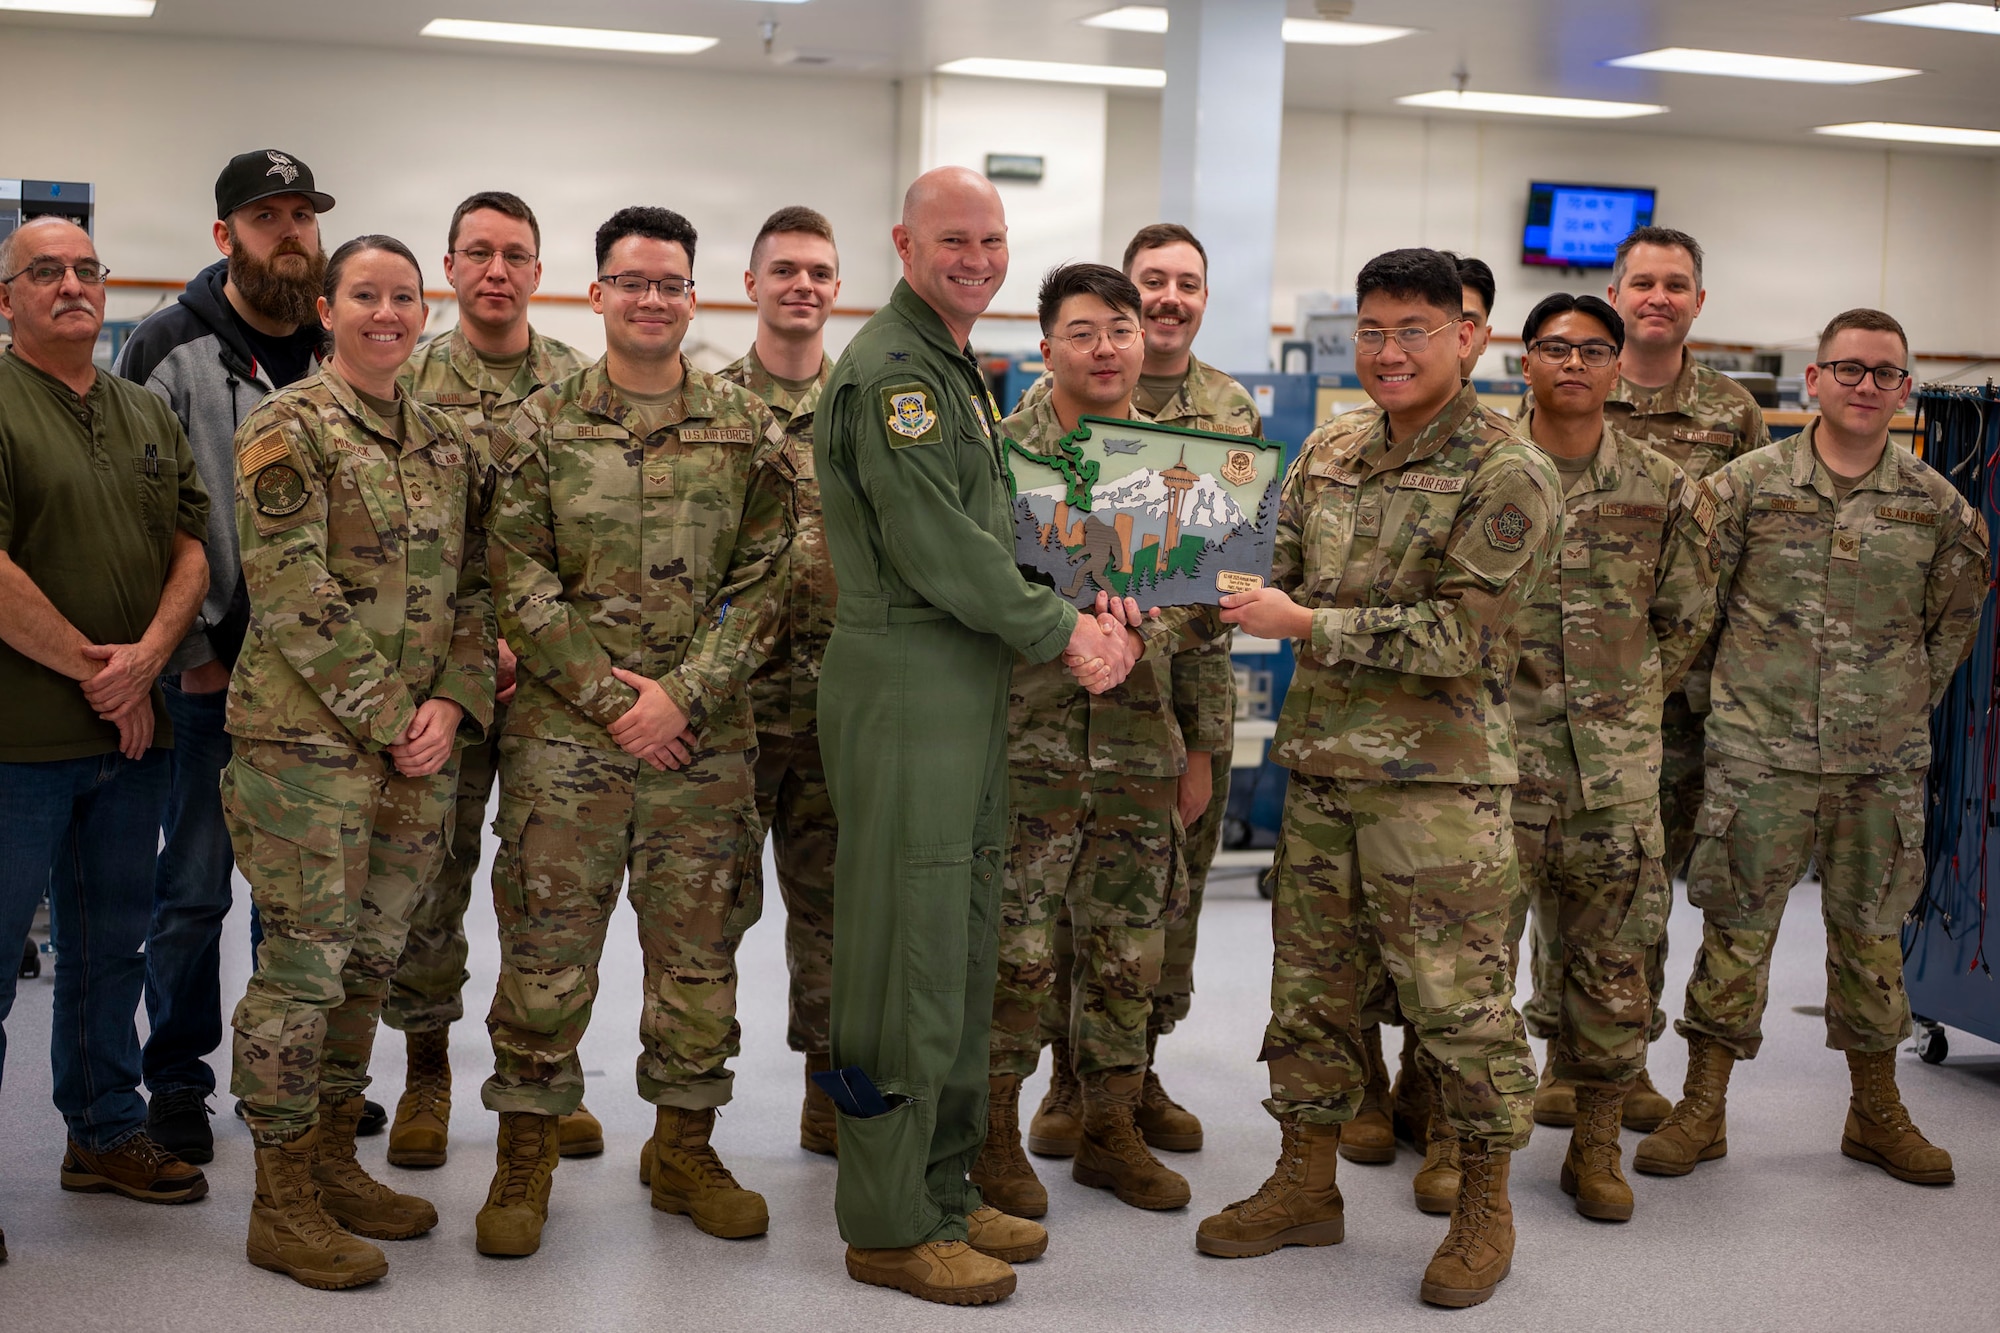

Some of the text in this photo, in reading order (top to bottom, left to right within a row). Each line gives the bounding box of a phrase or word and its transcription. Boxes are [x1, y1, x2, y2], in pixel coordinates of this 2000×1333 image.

[577, 426, 604, 437] BELL
[1212, 423, 1224, 432] AIR
[1225, 425, 1249, 434] FORCE
[684, 429, 750, 441] U.S. AIR FORCE
[1692, 431, 1705, 440] AIR
[1707, 432, 1731, 445] FORCE
[445, 453, 460, 464] AIR
[1323, 465, 1352, 482] LOPEZ
[1402, 474, 1461, 491] U.S. AIR FORCE
[1602, 503, 1619, 515] U.S.
[1880, 506, 1936, 525] U.S. AIR FORCE
